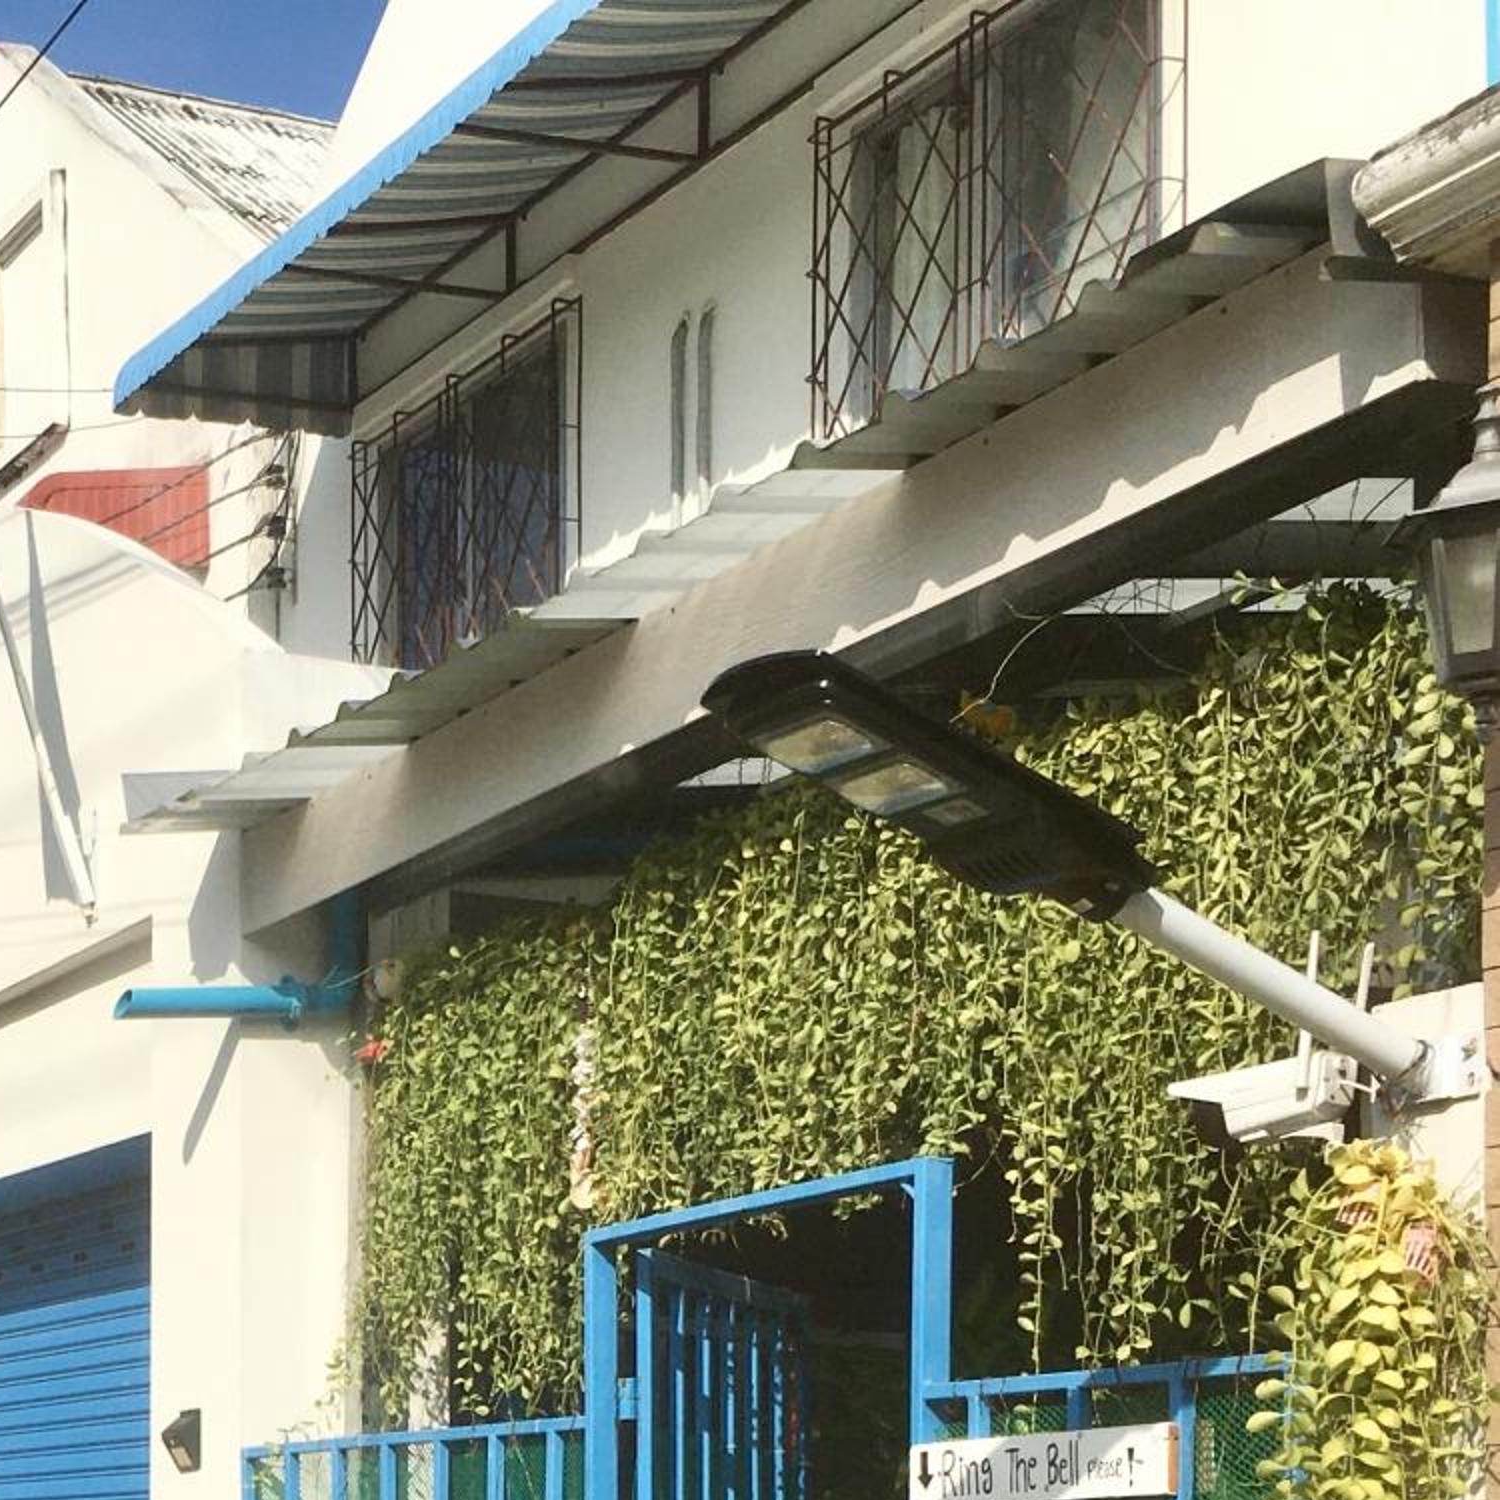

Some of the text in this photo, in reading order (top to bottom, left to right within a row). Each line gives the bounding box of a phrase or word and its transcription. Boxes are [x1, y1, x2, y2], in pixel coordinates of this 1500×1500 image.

[941, 1449, 993, 1498] Ring
[1004, 1447, 1037, 1493] The
[1046, 1440, 1080, 1490] Bell
